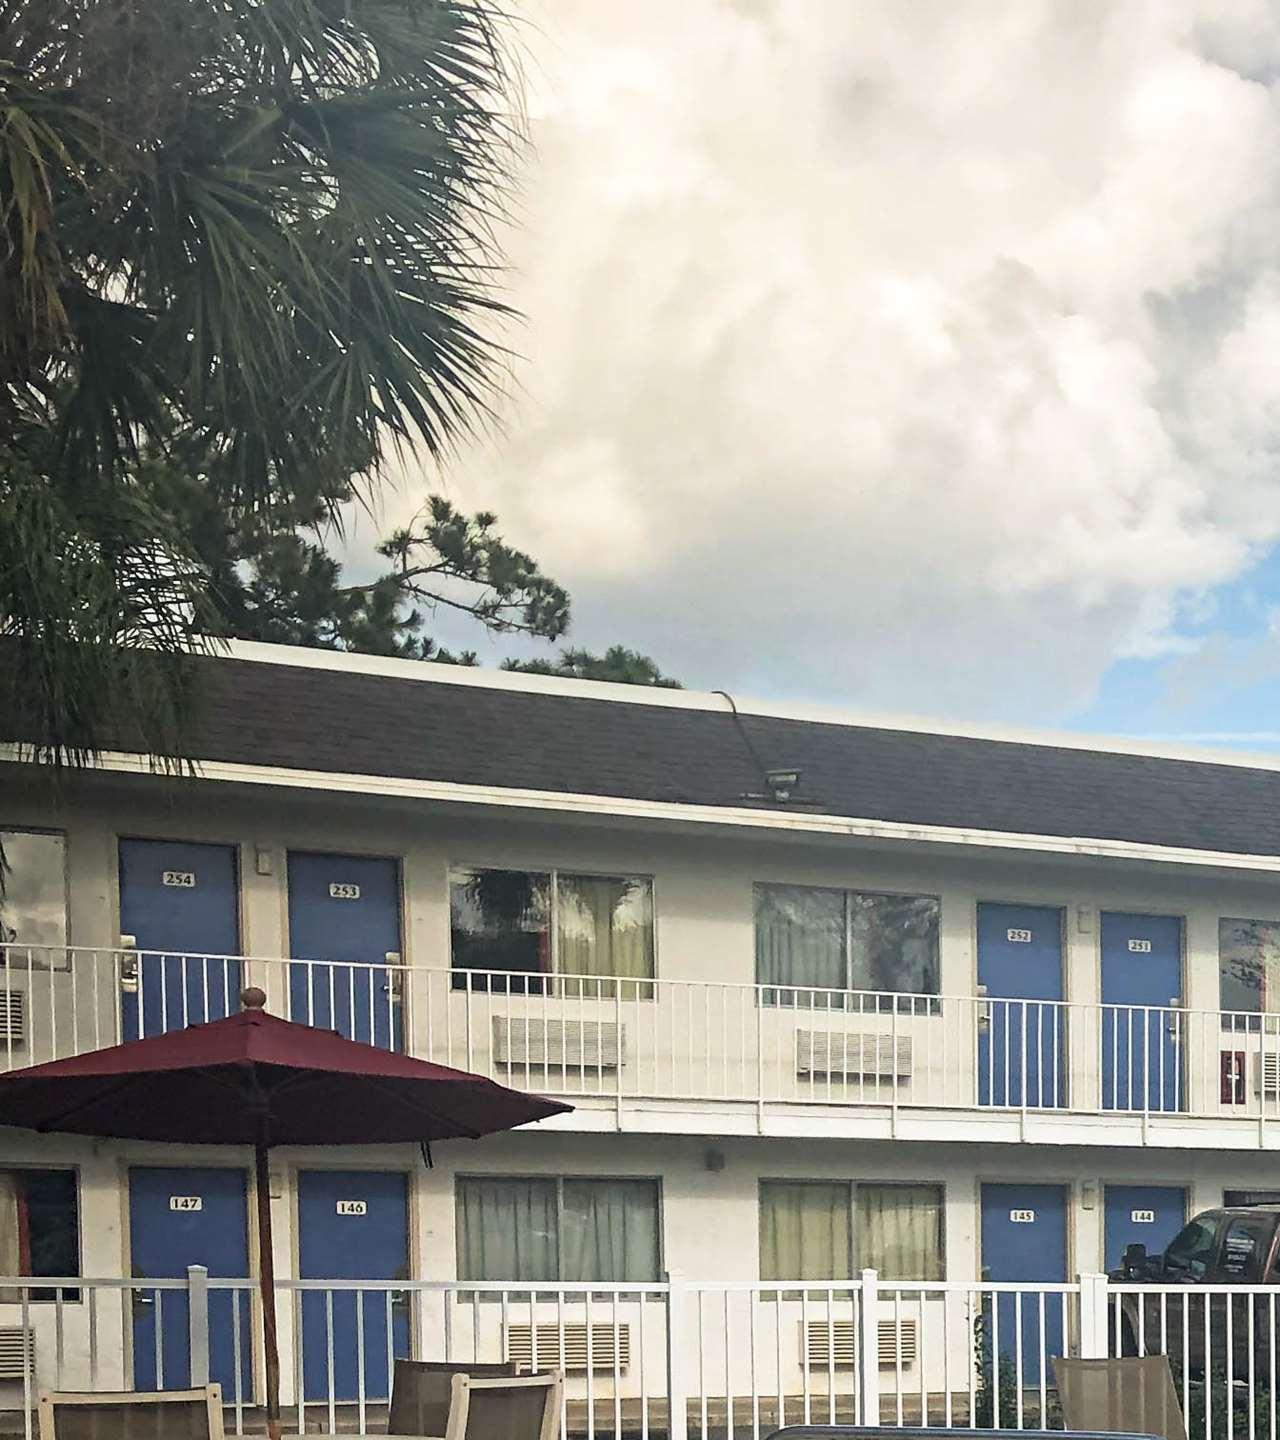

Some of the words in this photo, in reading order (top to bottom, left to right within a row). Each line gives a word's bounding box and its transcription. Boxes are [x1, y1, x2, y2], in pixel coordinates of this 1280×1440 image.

[166, 873, 191, 885] 254
[174, 1198, 198, 1209] 147
[341, 1203, 363, 1213] 146
